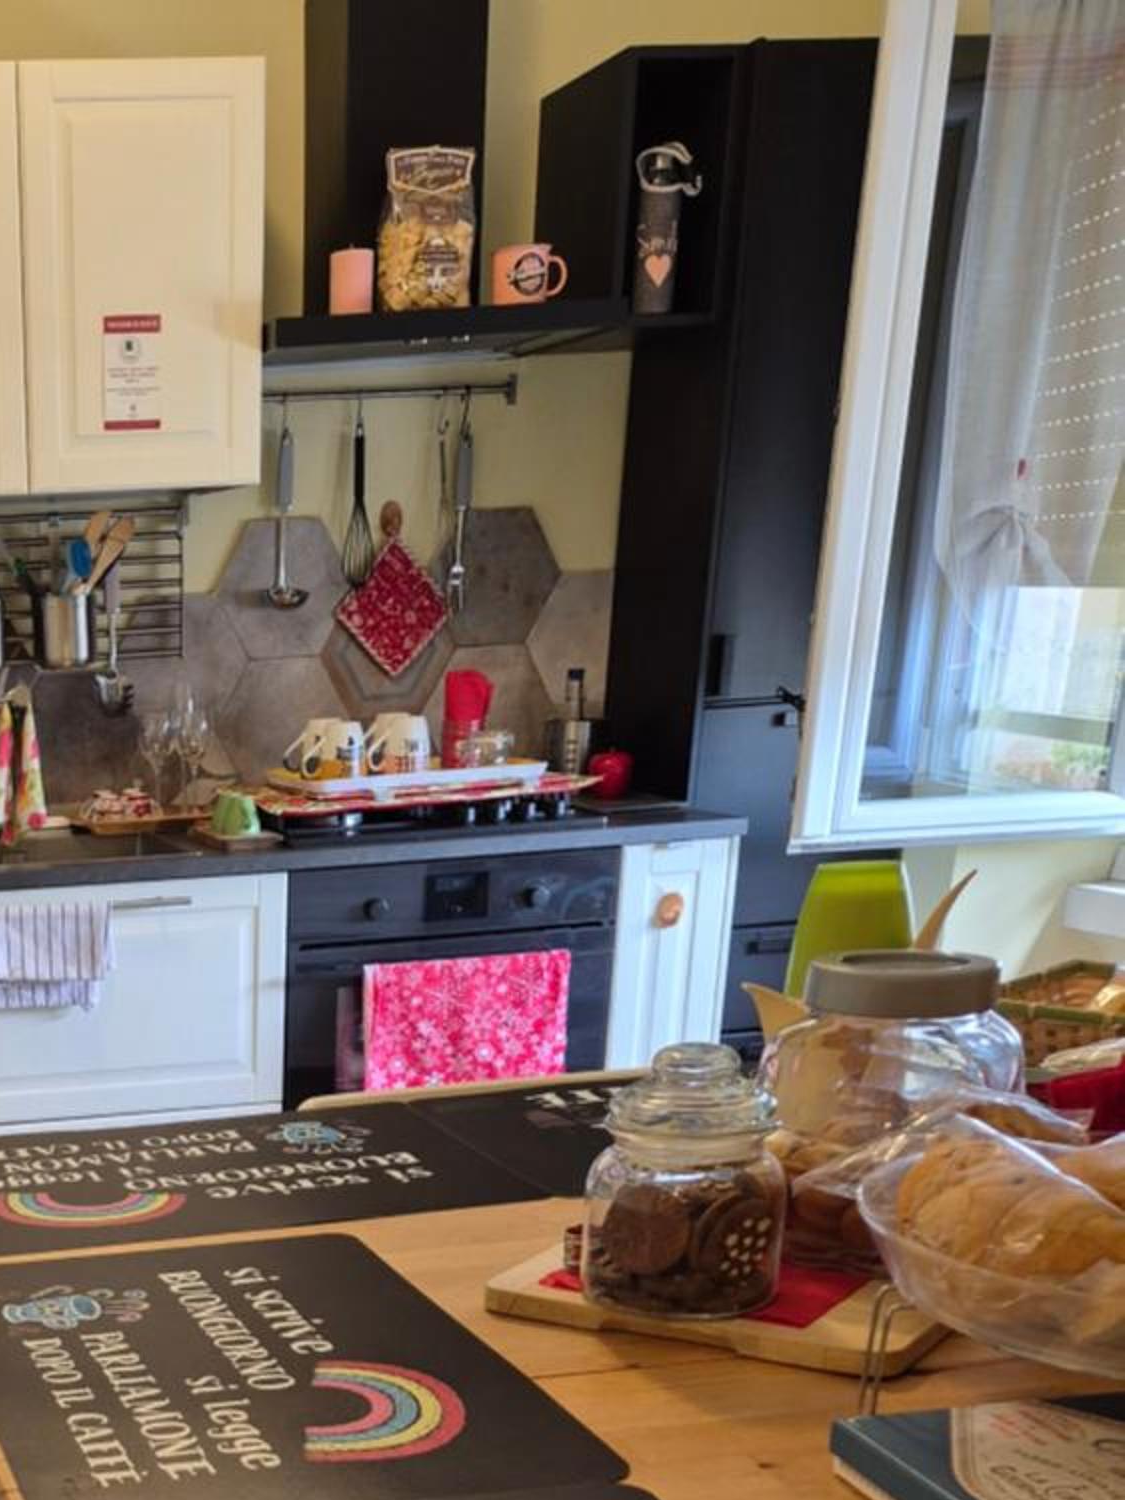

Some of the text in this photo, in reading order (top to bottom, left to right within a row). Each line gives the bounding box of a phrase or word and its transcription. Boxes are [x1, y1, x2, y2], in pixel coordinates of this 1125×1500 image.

[158, 1270, 295, 1390] BUONGIORNO
[224, 1267, 333, 1354] si scrive
[23, 1337, 82, 1383] DOPO
[51, 1388, 94, 1408] IL
[80, 1331, 216, 1480] PARLIAMONE
[186, 1375, 281, 1470] si legge
